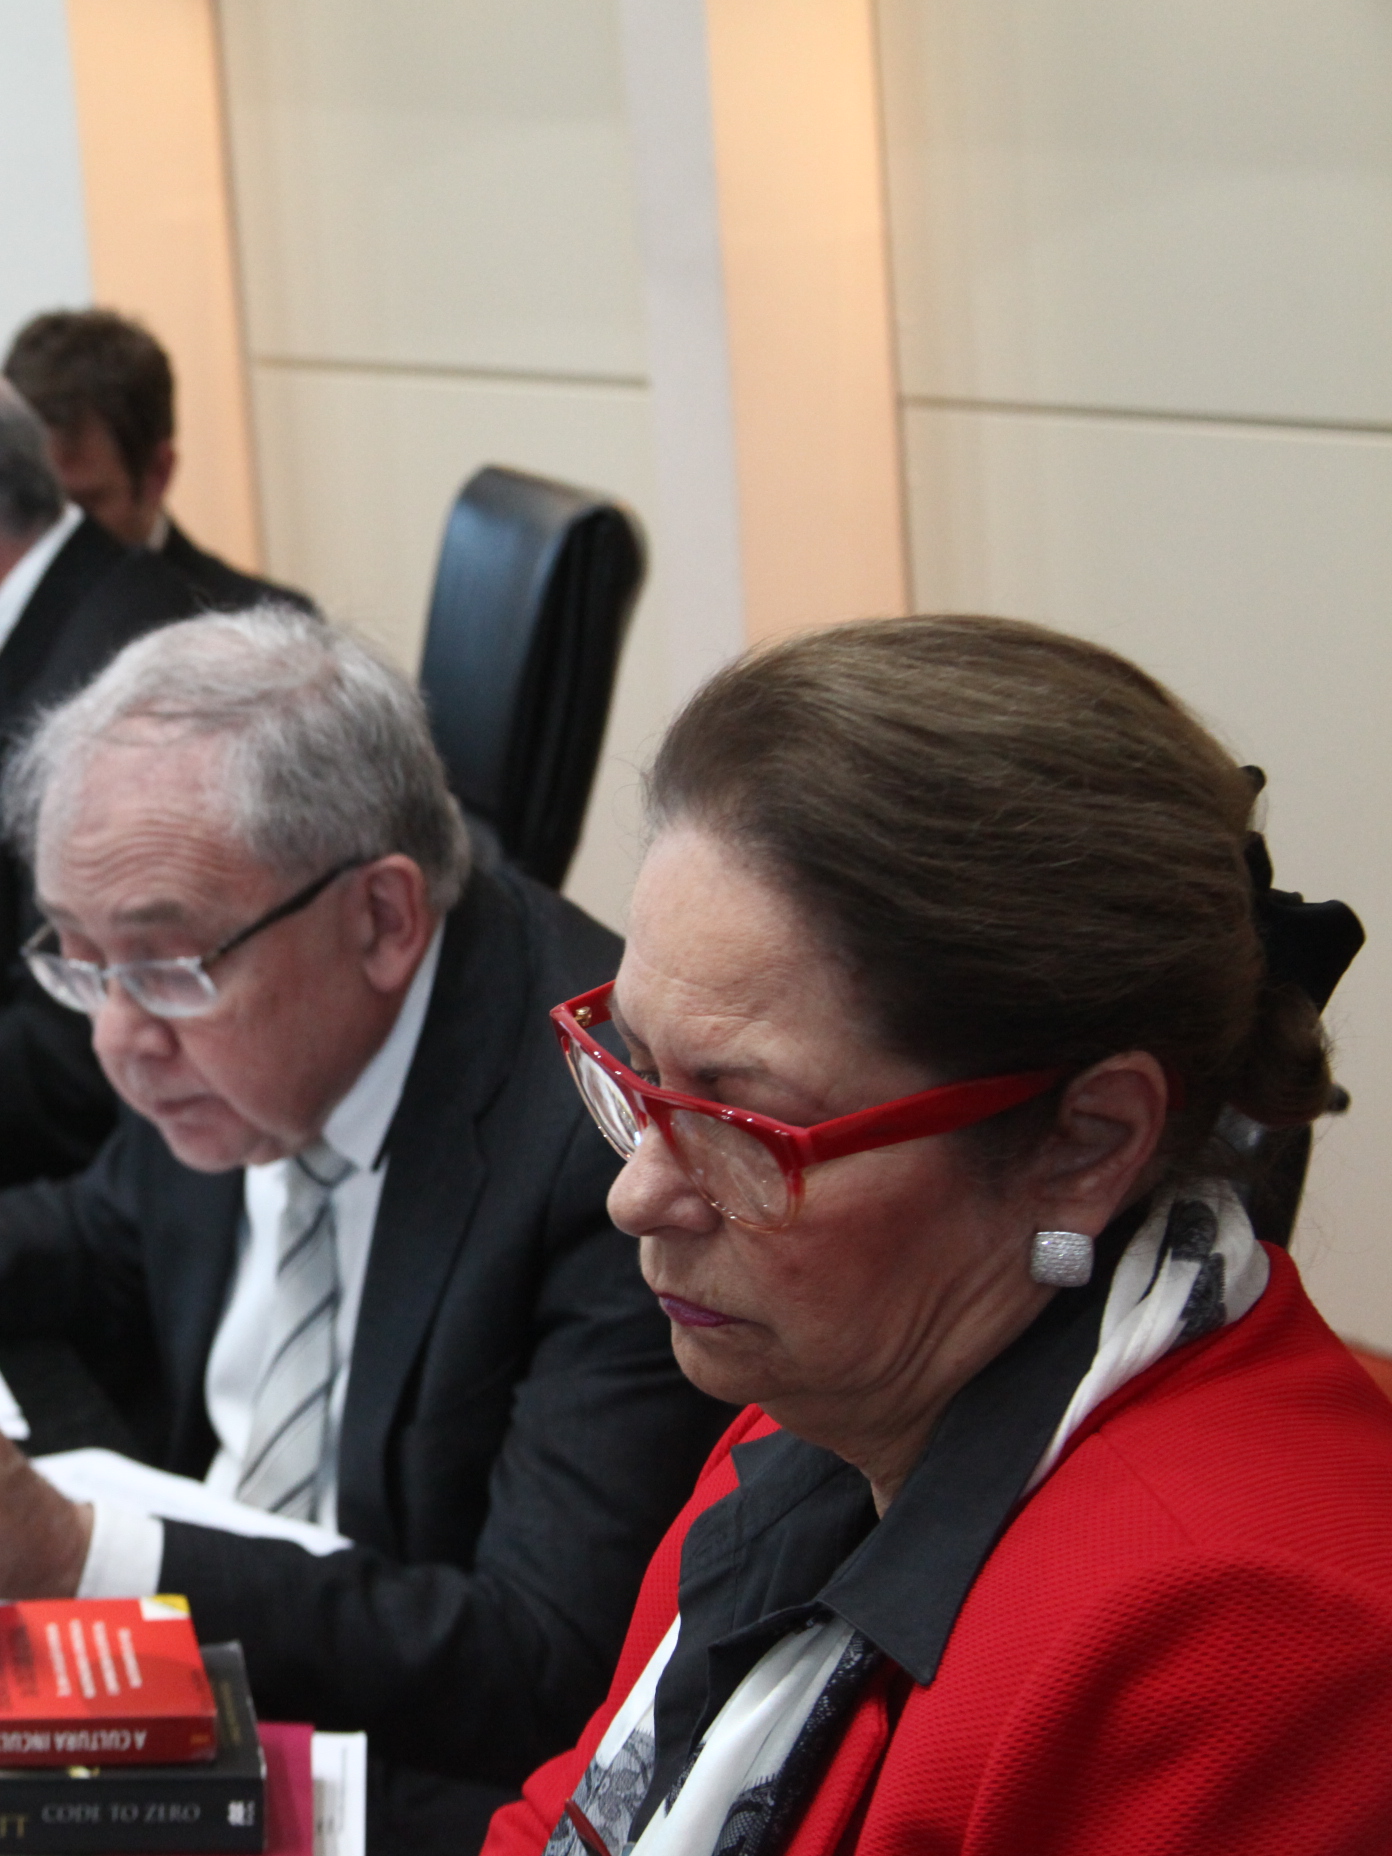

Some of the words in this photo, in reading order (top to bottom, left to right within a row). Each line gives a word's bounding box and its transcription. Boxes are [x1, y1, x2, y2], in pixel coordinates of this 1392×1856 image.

[54, 1730, 132, 1752] CULTURA
[134, 1729, 148, 1751] A
[40, 1802, 102, 1825] CODE
[110, 1803, 141, 1825] TO
[143, 1802, 203, 1825] ZERO
